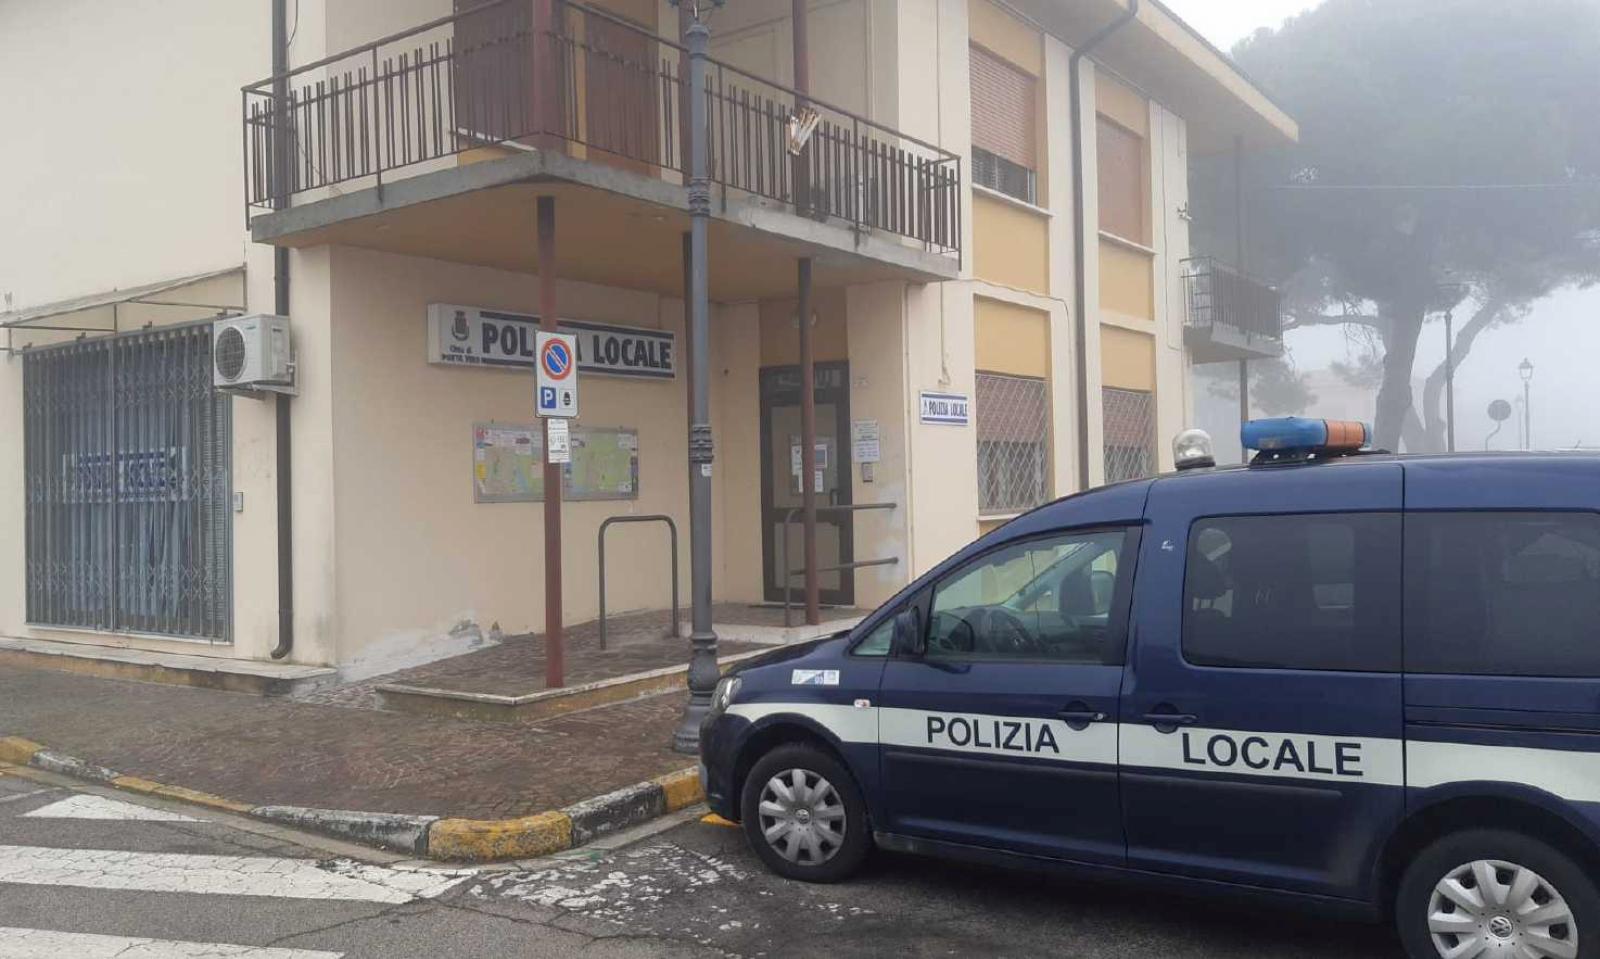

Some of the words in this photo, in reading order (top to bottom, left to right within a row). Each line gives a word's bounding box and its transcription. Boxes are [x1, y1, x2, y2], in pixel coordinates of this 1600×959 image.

[594, 335, 672, 369] LOCALE
[544, 389, 553, 406] P
[927, 716, 1060, 754] POLIZIA
[1183, 733, 1364, 777] LOCALE
